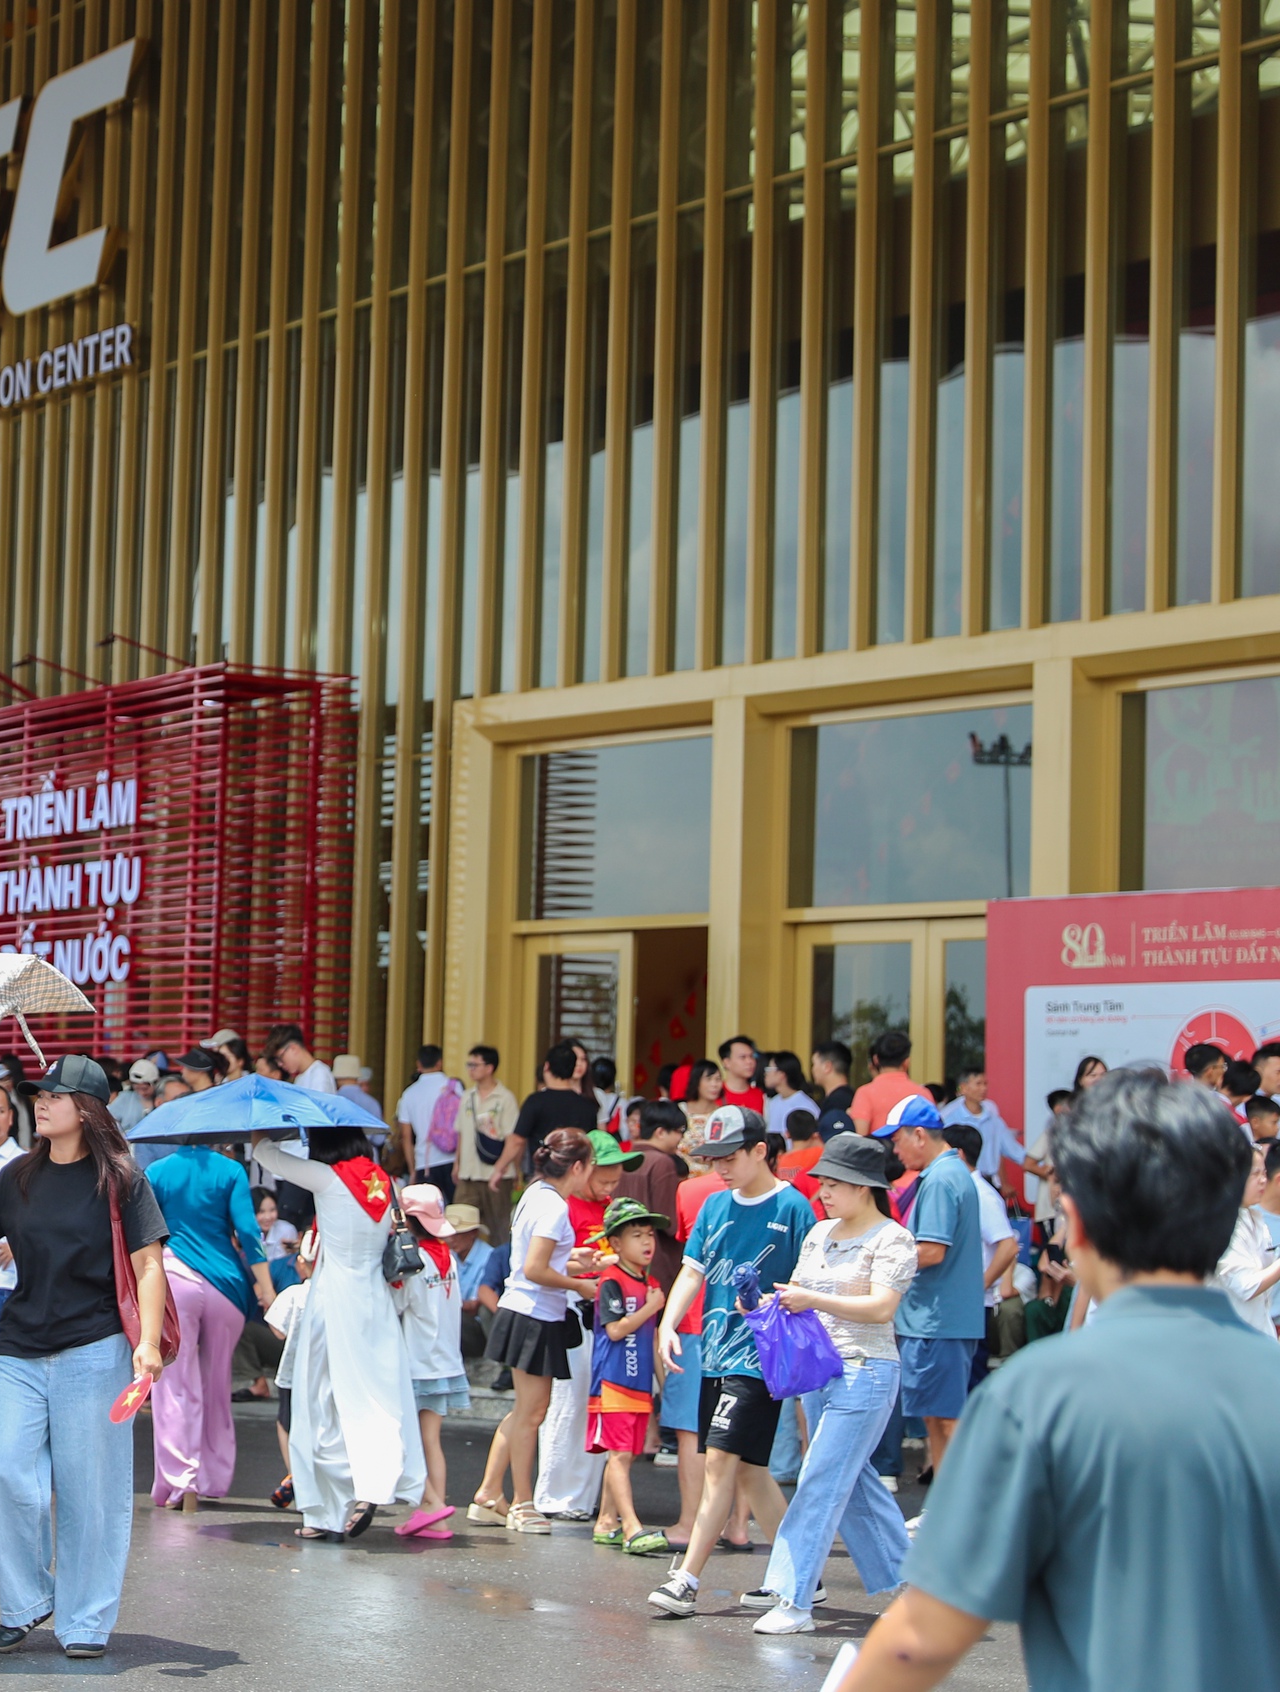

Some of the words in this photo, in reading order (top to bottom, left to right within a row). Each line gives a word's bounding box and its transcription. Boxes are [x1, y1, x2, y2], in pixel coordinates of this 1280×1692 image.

[36, 322, 133, 394] CENTER
[1, 770, 75, 842] TRIỂN
[76, 769, 138, 833] LÃM
[84, 852, 142, 921] TỰU
[1142, 946, 1198, 967] THÀNH
[625, 1350, 638, 1377] 2022
